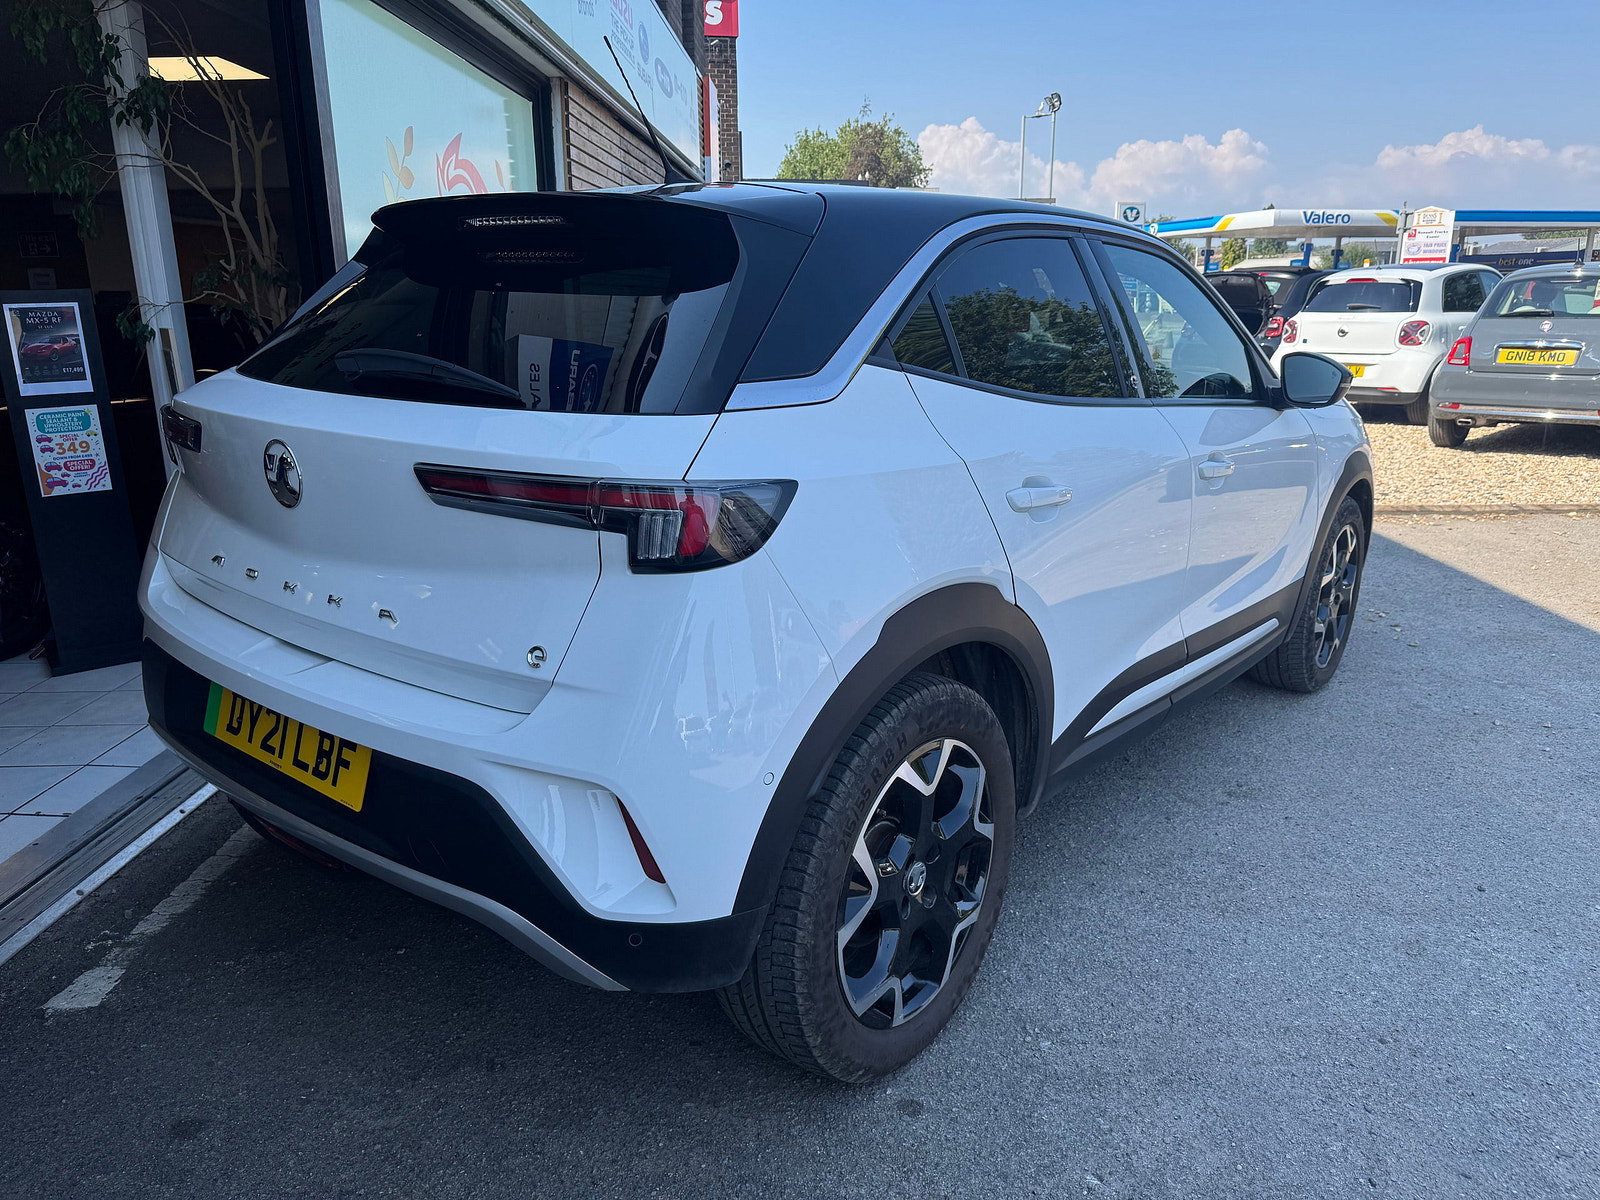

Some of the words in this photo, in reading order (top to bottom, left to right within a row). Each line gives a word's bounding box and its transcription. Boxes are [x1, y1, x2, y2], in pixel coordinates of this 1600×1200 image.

[1303, 211, 1351, 224] Valero
[1506, 351, 1536, 361] GN18
[1538, 351, 1566, 362] KMO
[55, 440, 90, 455] 349
[211, 554, 398, 623] MOKKA
[226, 692, 289, 760] DY21
[292, 722, 358, 788] LBF
